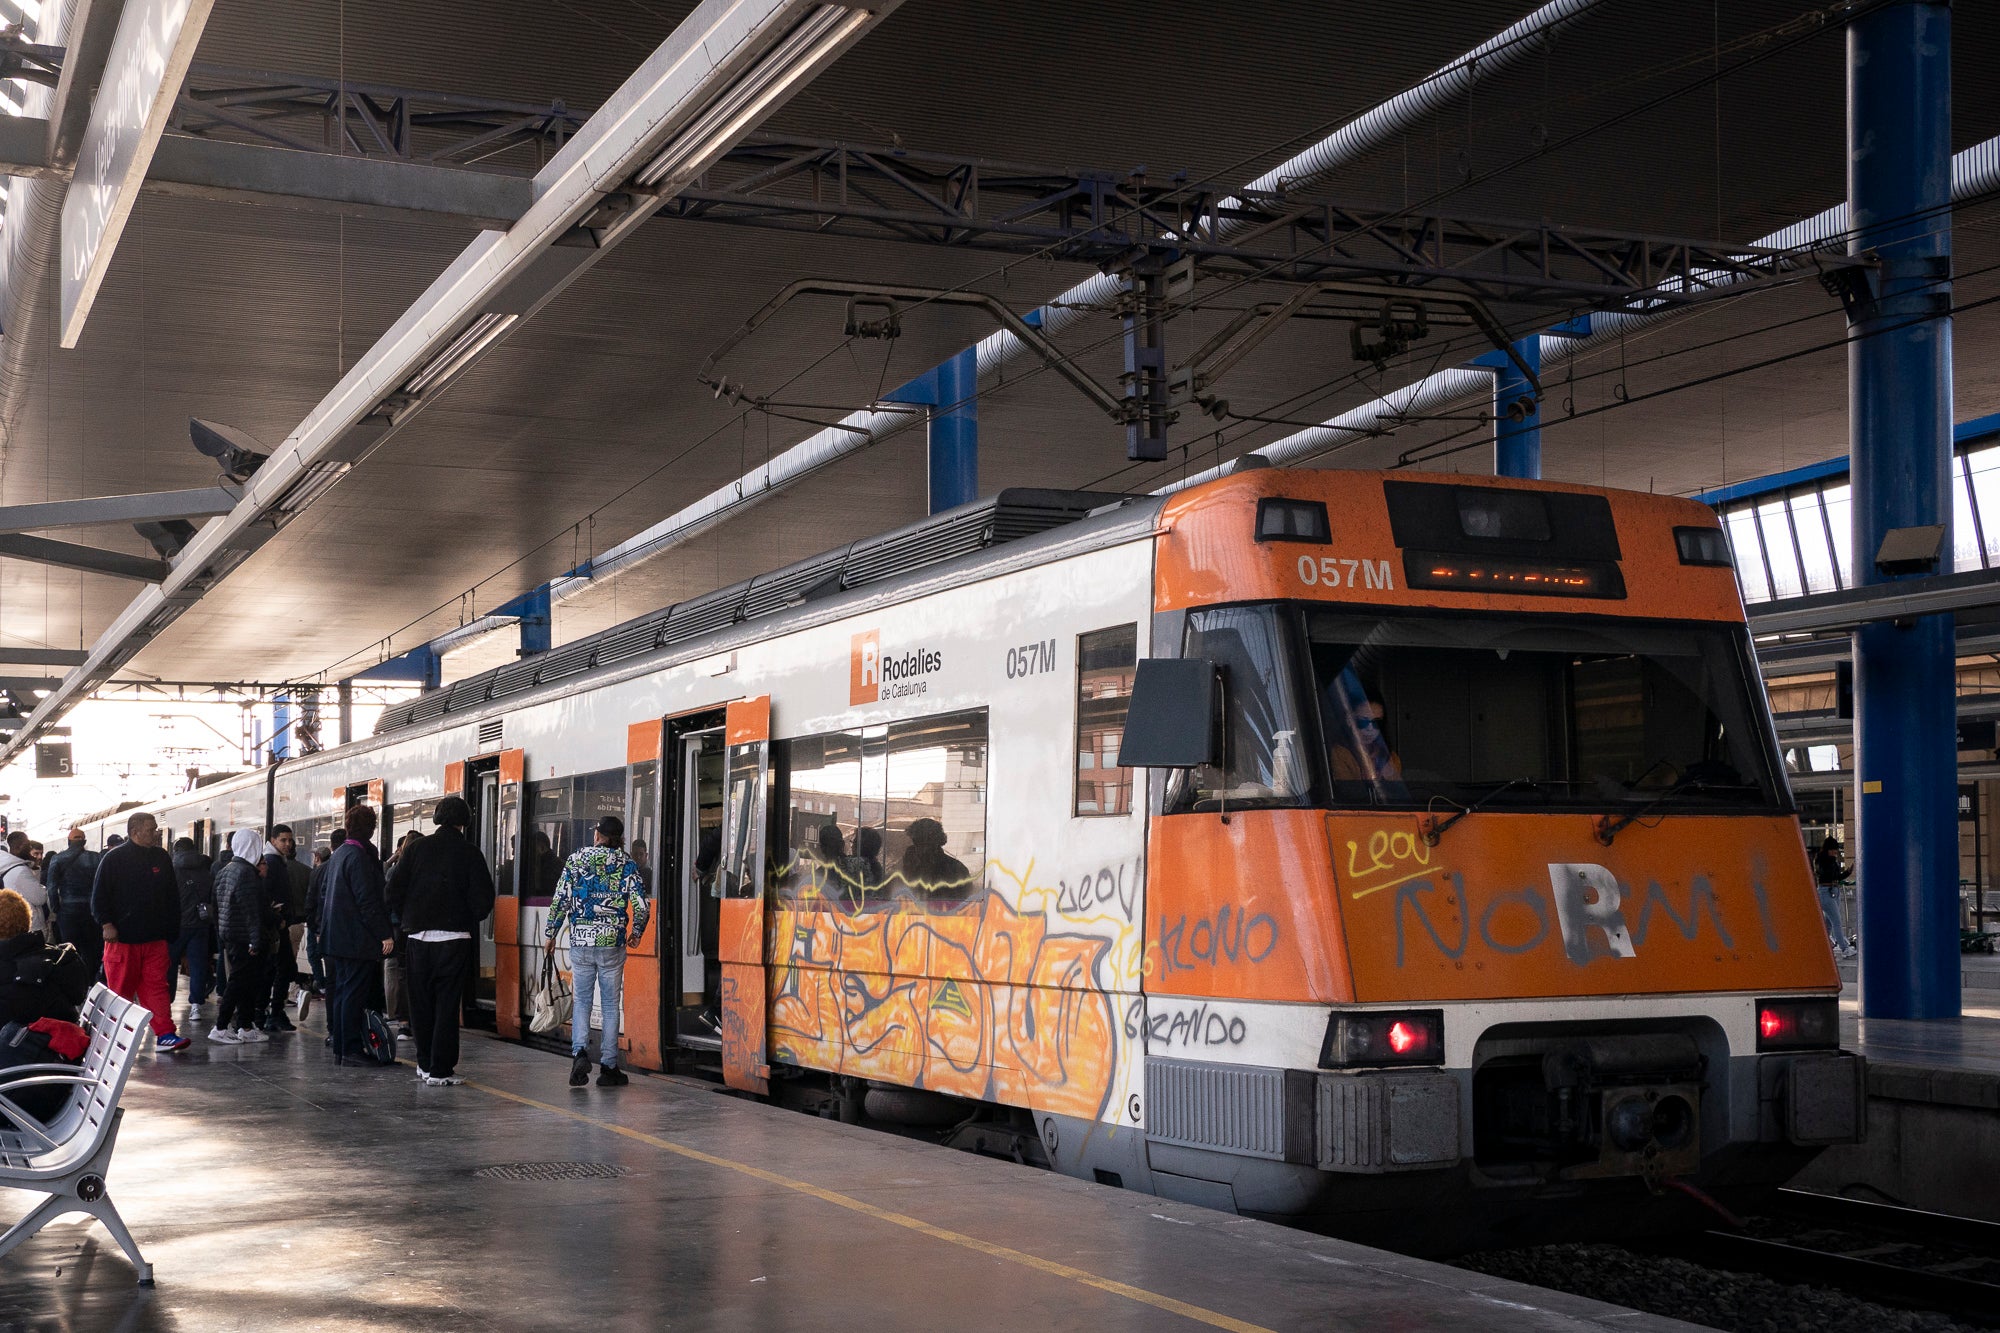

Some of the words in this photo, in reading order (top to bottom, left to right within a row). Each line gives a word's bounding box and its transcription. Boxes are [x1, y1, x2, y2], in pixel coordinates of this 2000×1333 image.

[1298, 555, 1394, 591] 057M
[883, 648, 942, 682] Rodalies
[1007, 639, 1056, 680] 057M
[881, 686, 891, 701] de
[892, 680, 927, 699] Catalunya
[60, 758, 69, 773] 5
